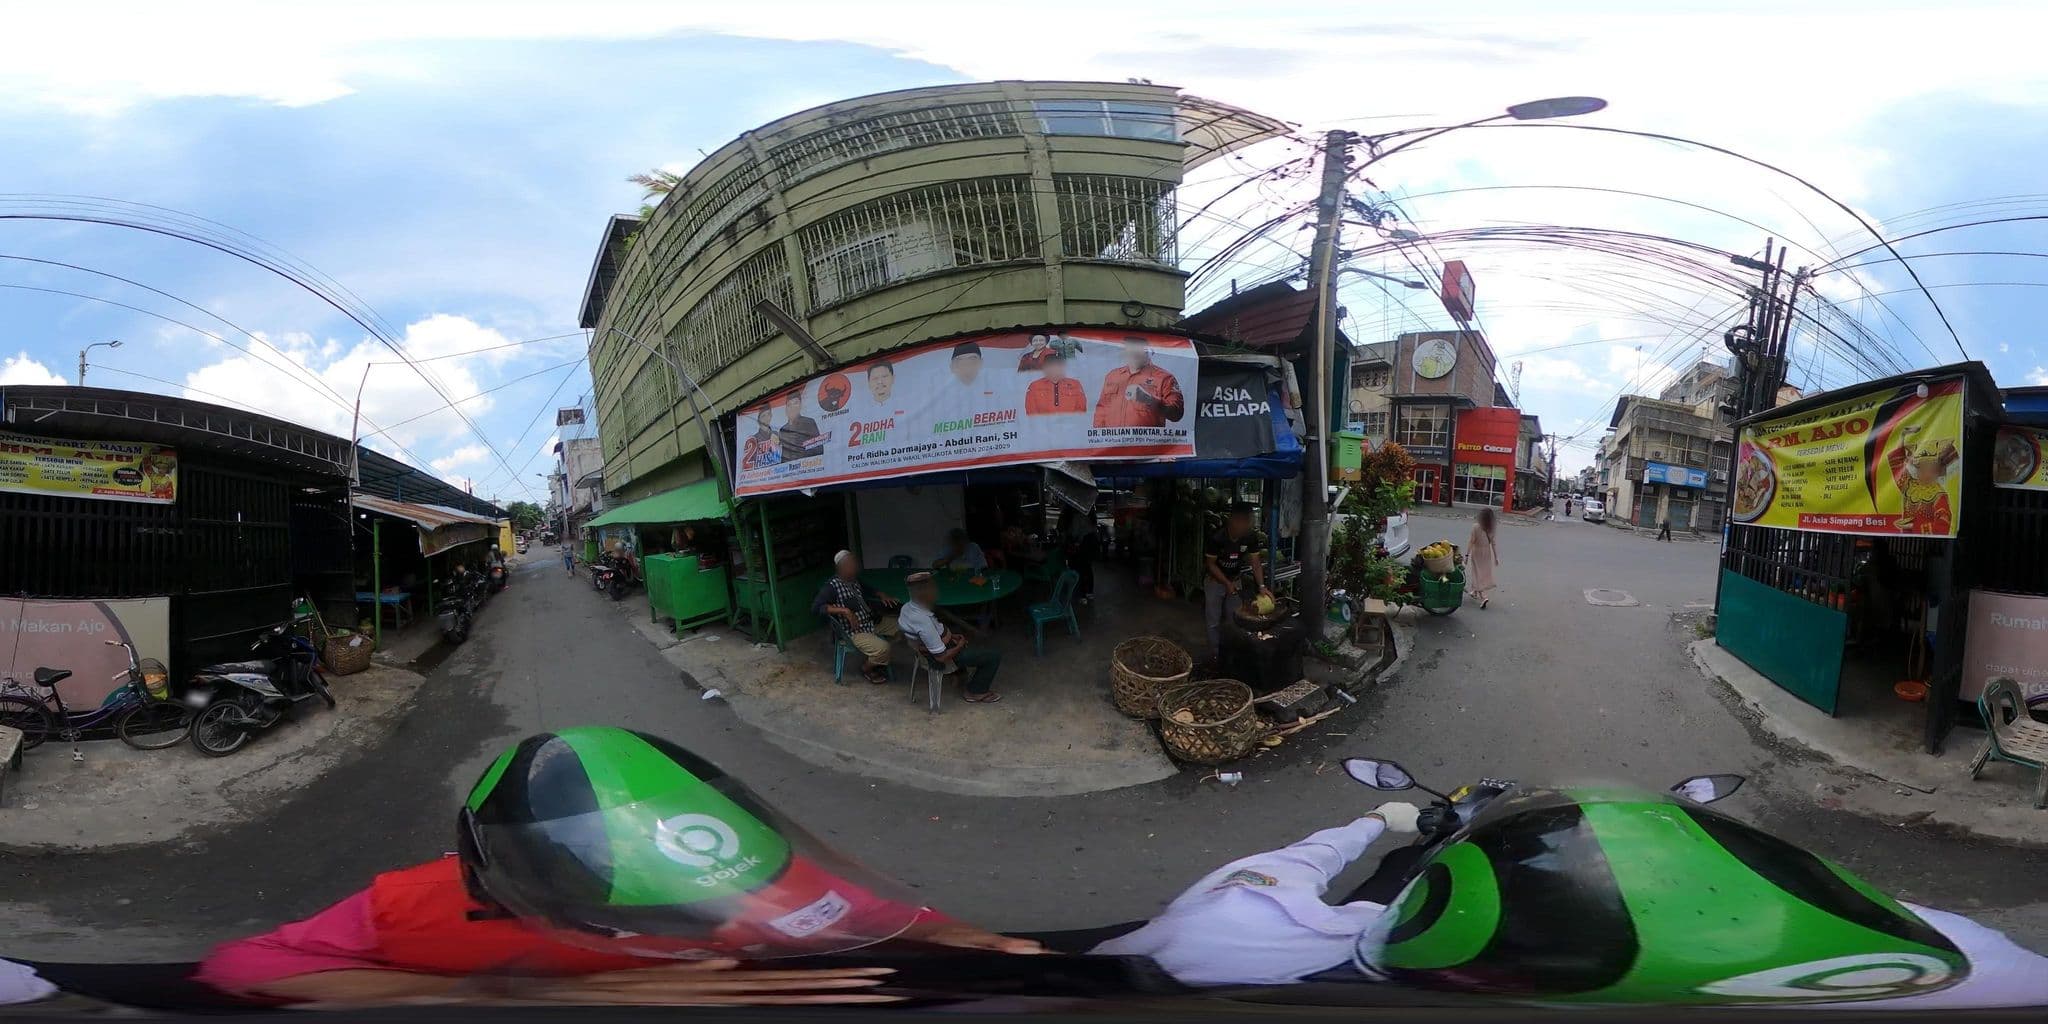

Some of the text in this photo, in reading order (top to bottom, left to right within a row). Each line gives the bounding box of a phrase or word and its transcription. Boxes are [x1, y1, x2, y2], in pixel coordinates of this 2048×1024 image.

[1213, 386, 1252, 401] ASIA
[1200, 401, 1271, 417] KELAPA
[933, 418, 972, 433] MEDAN
[974, 408, 1016, 425] BERANI
[848, 421, 862, 447] 2
[863, 418, 895, 433] RIDHA
[862, 431, 886, 444] RANI
[1101, 428, 1130, 437] BRILIAN
[1811, 418, 1869, 441] AJO
[848, 452, 865, 462] Prof.
[867, 450, 889, 459] Ridha
[891, 443, 937, 456] Darmajaya
[945, 436, 973, 447] Abdul
[975, 434, 1000, 443] Rani,
[1003, 431, 1018, 440] SH
[870, 458, 897, 466] WALIKOTA
[922, 450, 952, 459] WALIKOTA
[1812, 516, 1828, 524] Asia
[1829, 517, 1863, 527] Simpang
[1866, 517, 1886, 526] Besi
[10, 619, 105, 635] Makan Ajo
[696, 855, 761, 888] gojek
